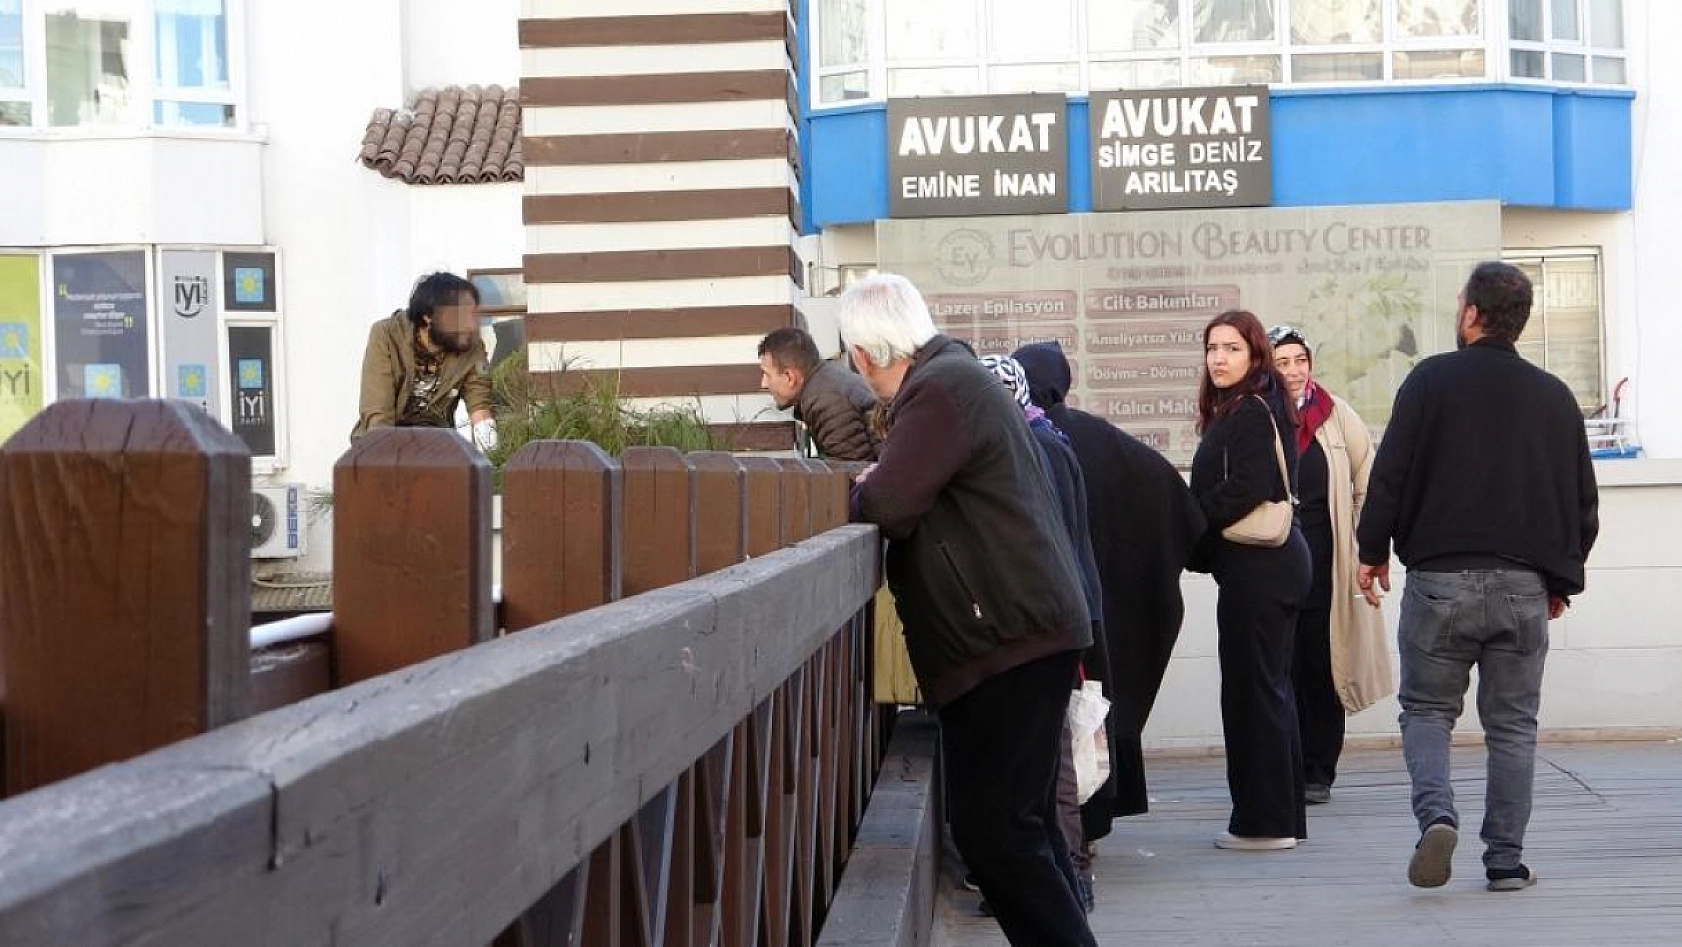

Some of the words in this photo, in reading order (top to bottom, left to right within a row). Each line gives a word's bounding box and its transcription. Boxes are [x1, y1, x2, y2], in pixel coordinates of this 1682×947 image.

[1100, 95, 1258, 139] AVUKAT
[899, 112, 1056, 156] AVUKAT
[1098, 140, 1176, 168] SİMGE
[1189, 136, 1263, 163] DENİZ
[902, 170, 980, 198] EMİNE
[995, 168, 1056, 197] İNAN
[1125, 168, 1239, 196] ARILITAŞ
[1008, 228, 1182, 268] EVOLUTION
[1192, 221, 1317, 260] BEAUTY
[1323, 221, 1431, 254] CENTER
[934, 303, 979, 315] Lazer
[984, 299, 1064, 316] Epilasyon
[1103, 293, 1133, 311] Cilt
[1137, 291, 1219, 310] Bakımları
